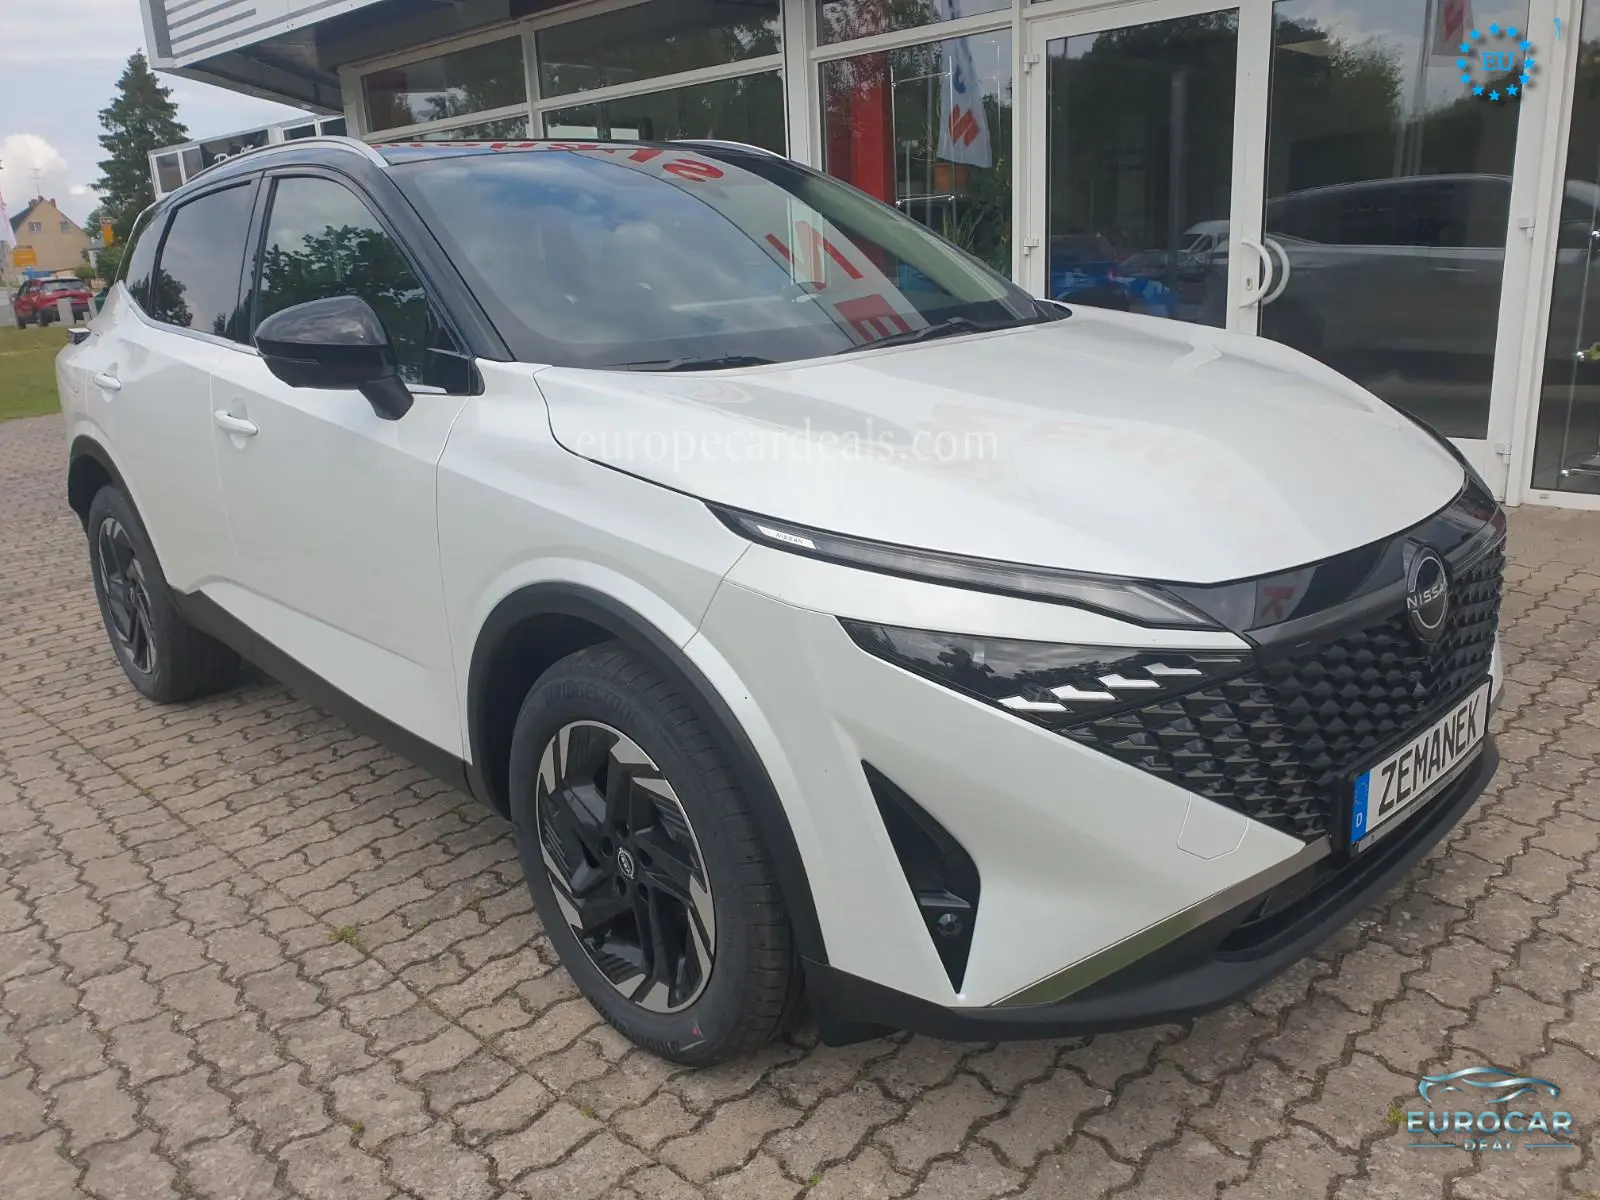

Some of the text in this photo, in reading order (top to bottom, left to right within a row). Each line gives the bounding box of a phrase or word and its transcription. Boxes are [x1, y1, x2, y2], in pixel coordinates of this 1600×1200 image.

[775, 531, 804, 545] NISSAN
[1378, 694, 1480, 817] ZEMANEK
[1355, 812, 1363, 828] D
